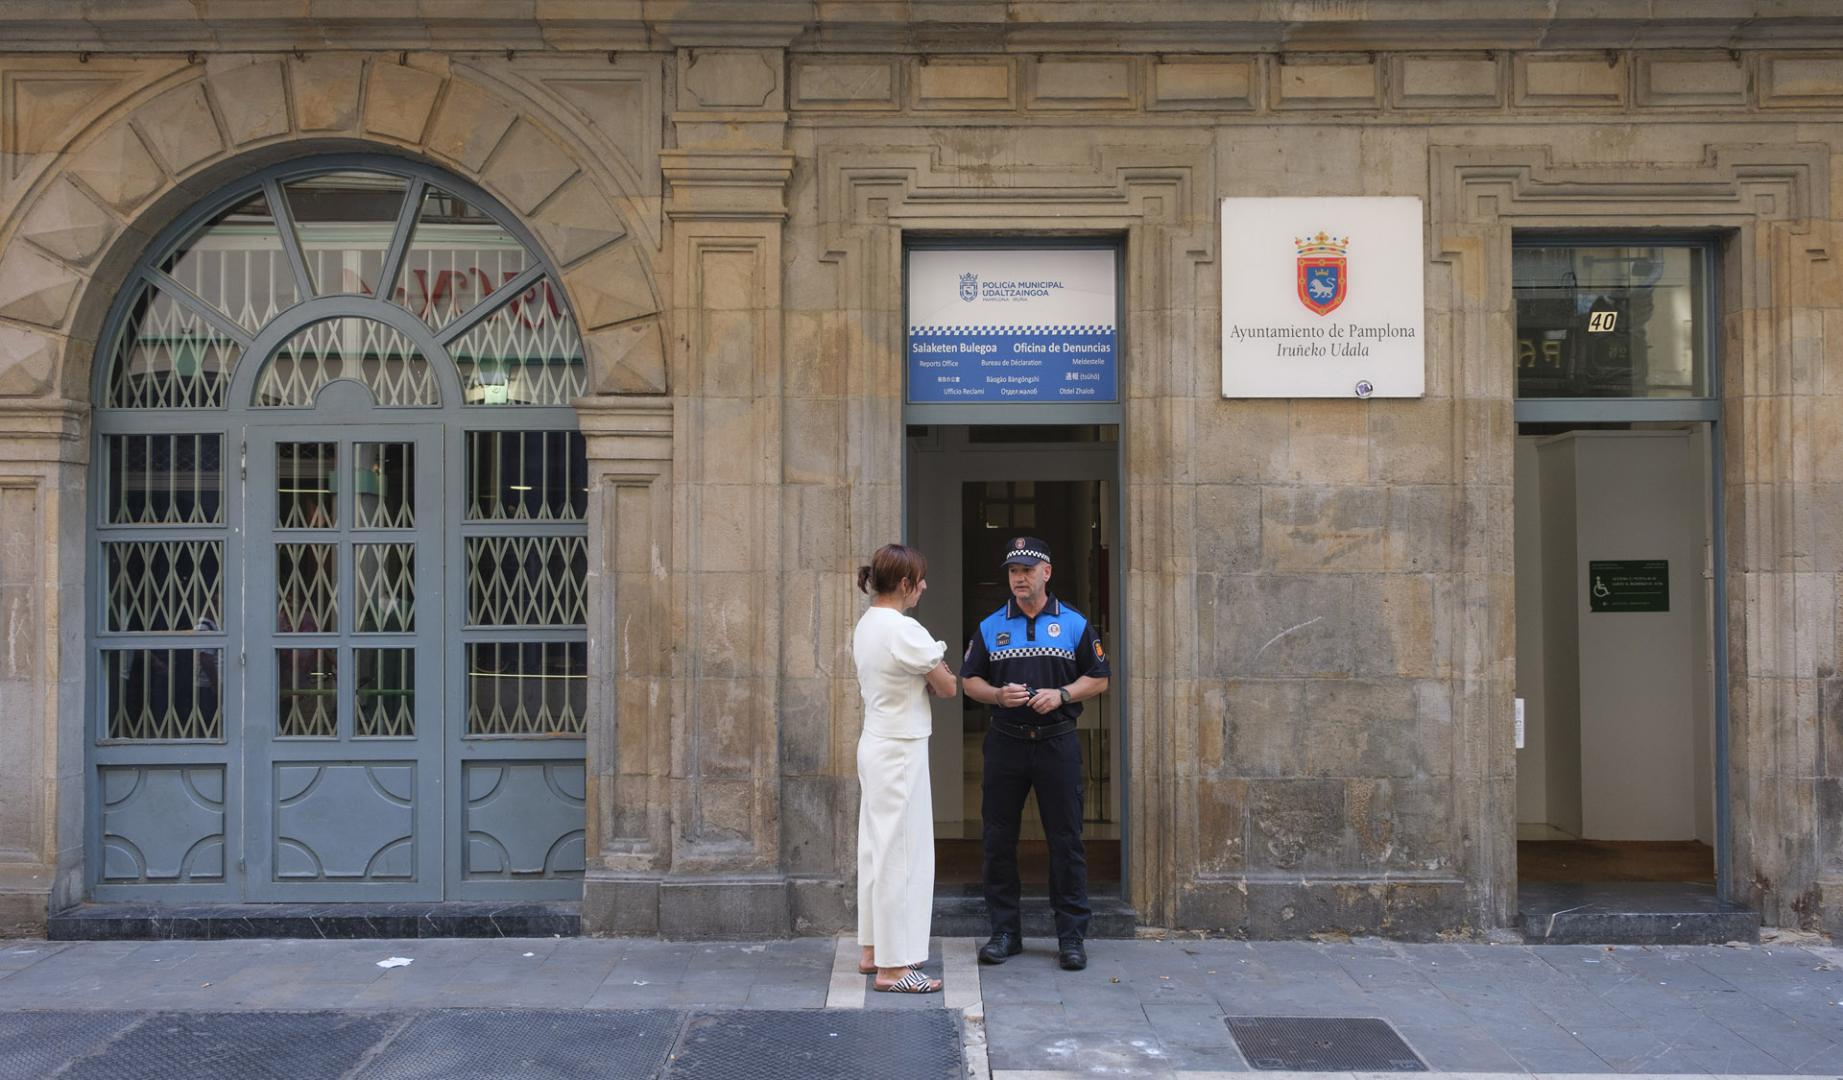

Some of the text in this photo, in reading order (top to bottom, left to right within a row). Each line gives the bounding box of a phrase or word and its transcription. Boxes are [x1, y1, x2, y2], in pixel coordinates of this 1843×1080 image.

[1018, 281, 1064, 289] MUNICIPAL
[982, 289, 1049, 297] UDALTZAINGOA
[1591, 313, 1616, 331] 40
[1230, 323, 1415, 342] Ayuntamiento de Pamplona
[912, 342, 998, 355] Salaketen Bulegoa
[1013, 342, 1111, 353] Oficina de Denuncias
[1277, 342, 1369, 357] Iruñeko Udala
[919, 360, 941, 368] Reports
[981, 359, 1042, 367] Bureau de Déclaration
[962, 387, 985, 395] Reclami
